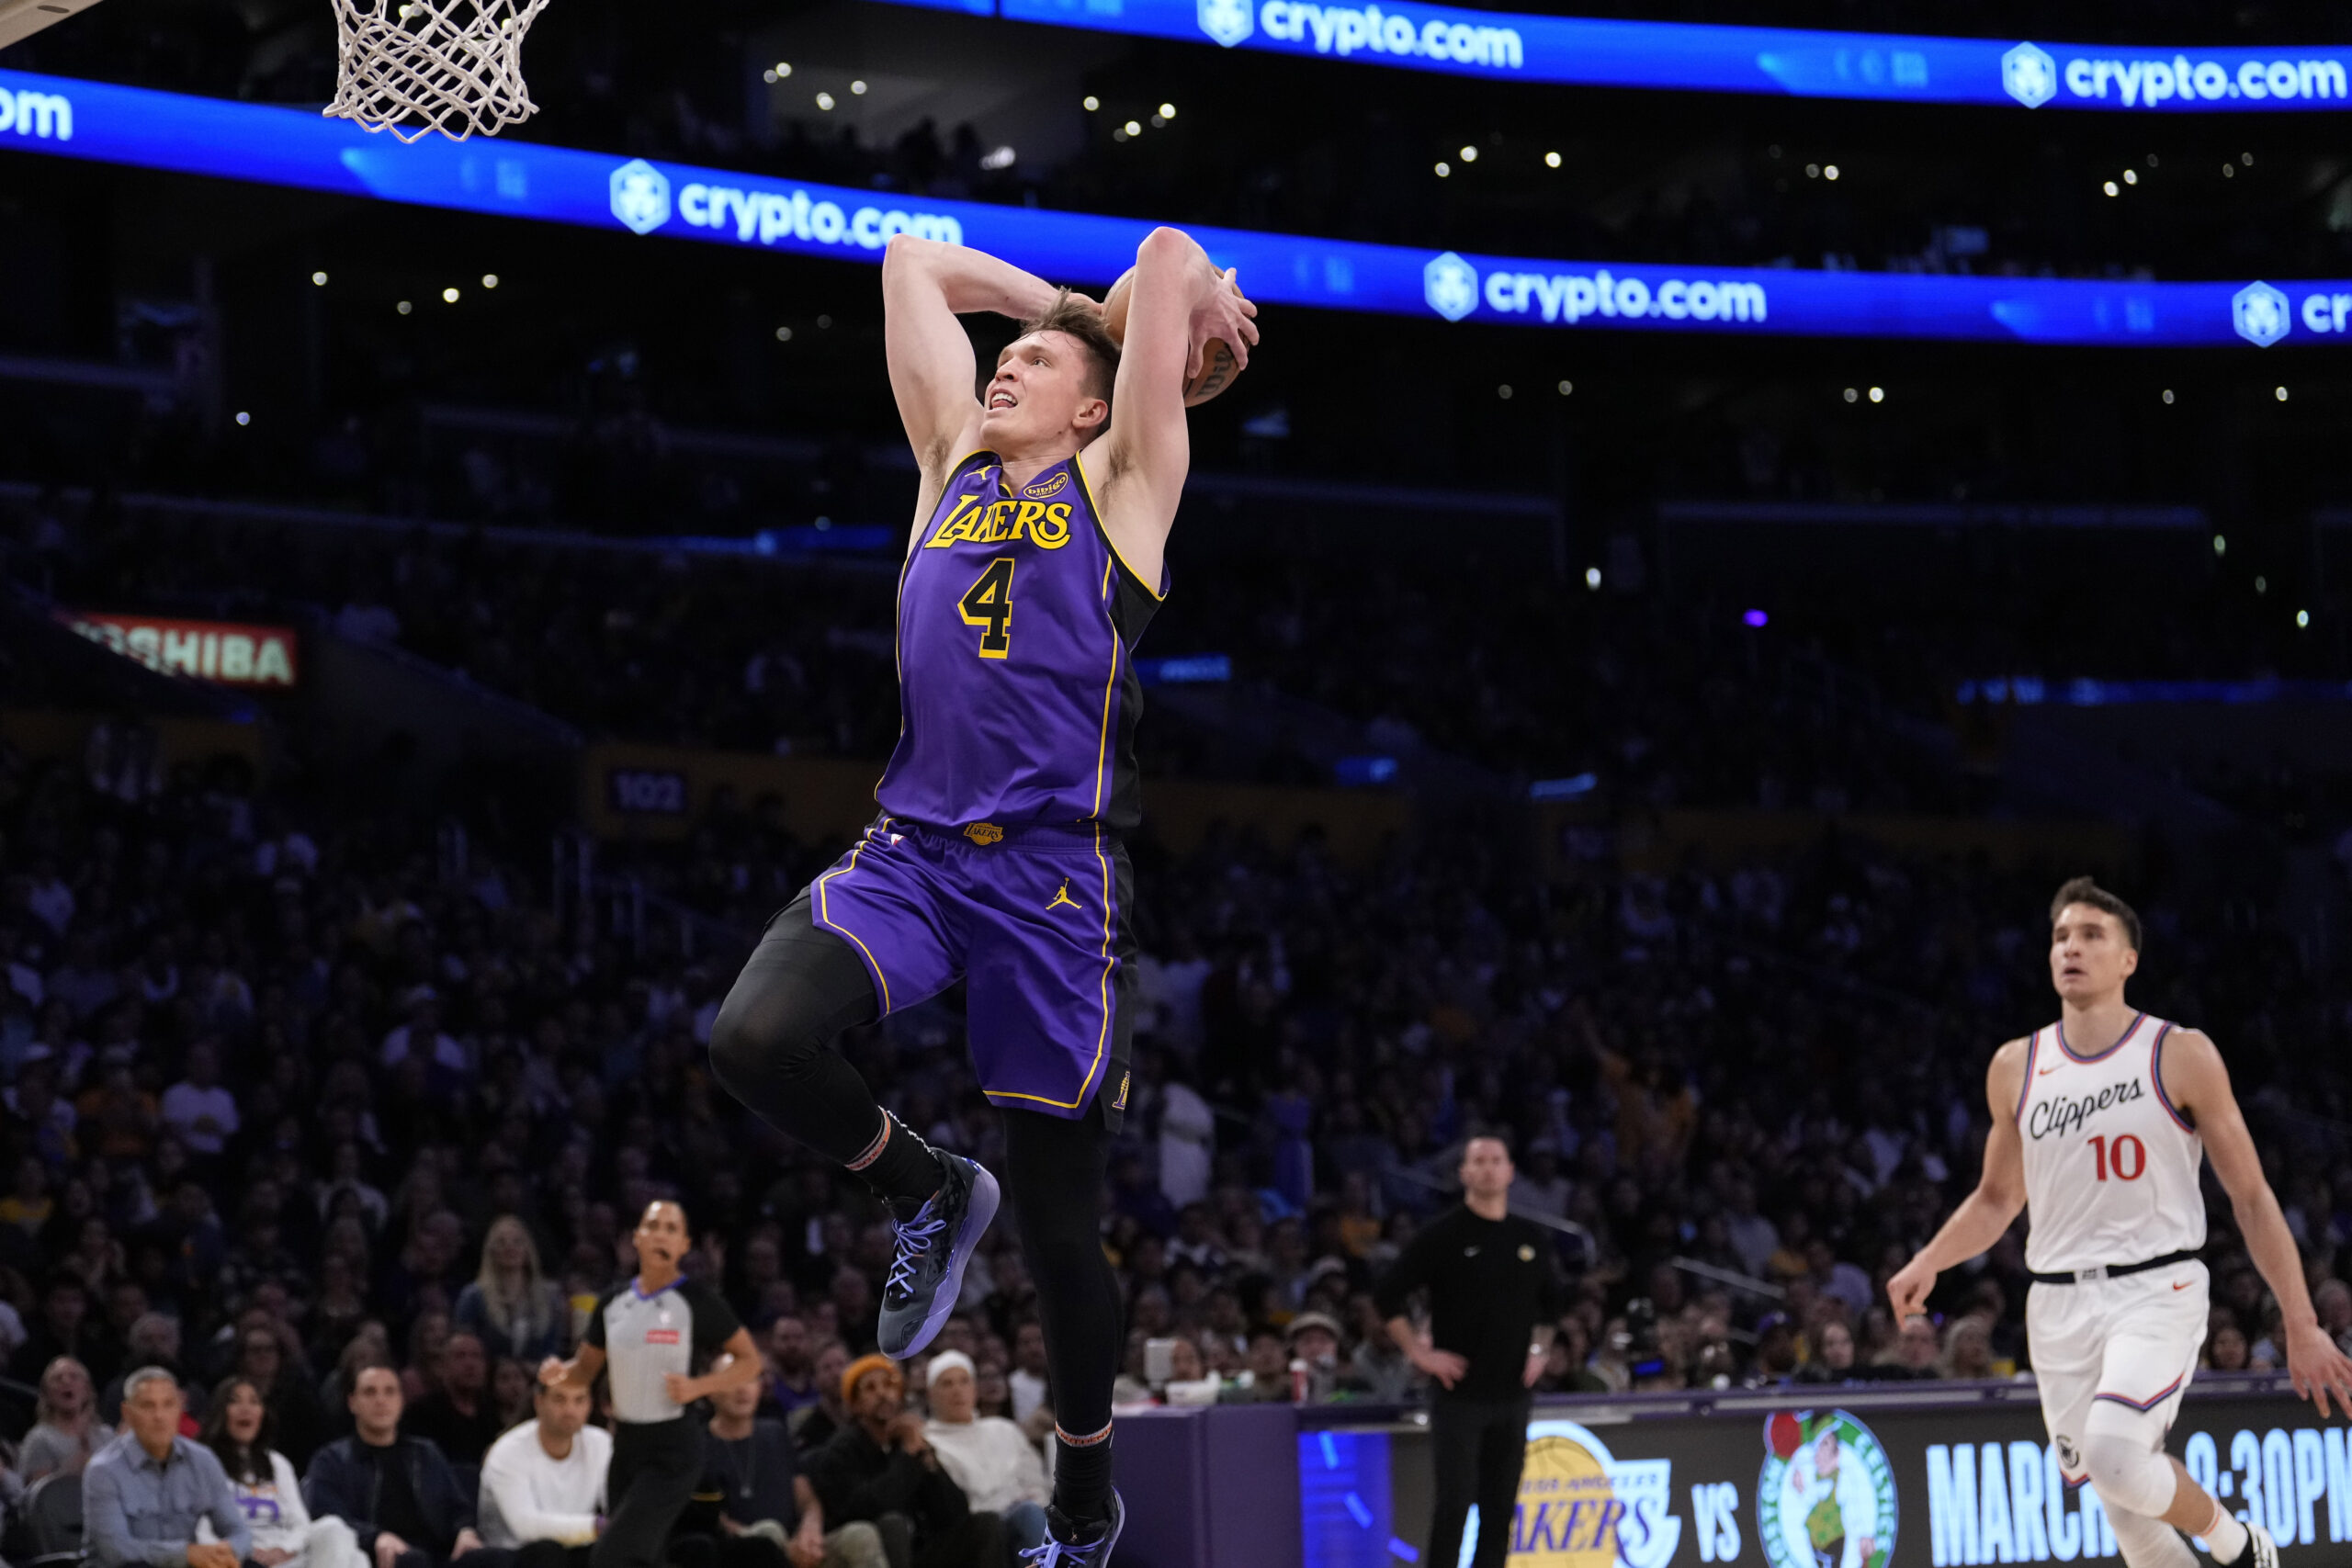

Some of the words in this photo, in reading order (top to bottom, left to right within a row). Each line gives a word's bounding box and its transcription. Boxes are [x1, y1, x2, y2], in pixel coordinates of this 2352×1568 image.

[1261, 0, 1523, 68] crypto.com
[2065, 54, 2347, 107] crypto.com
[678, 183, 963, 250] crypto.com
[1485, 270, 1767, 323] crypto.com
[1028, 476, 1066, 494] bibigo
[924, 494, 1073, 549] LAKERS
[957, 558, 1015, 660] 4
[74, 621, 295, 686] SHIBA
[2030, 1077, 2144, 1140] Clippers
[2086, 1134, 2146, 1182] 10
[1691, 1481, 1741, 1562] VS
